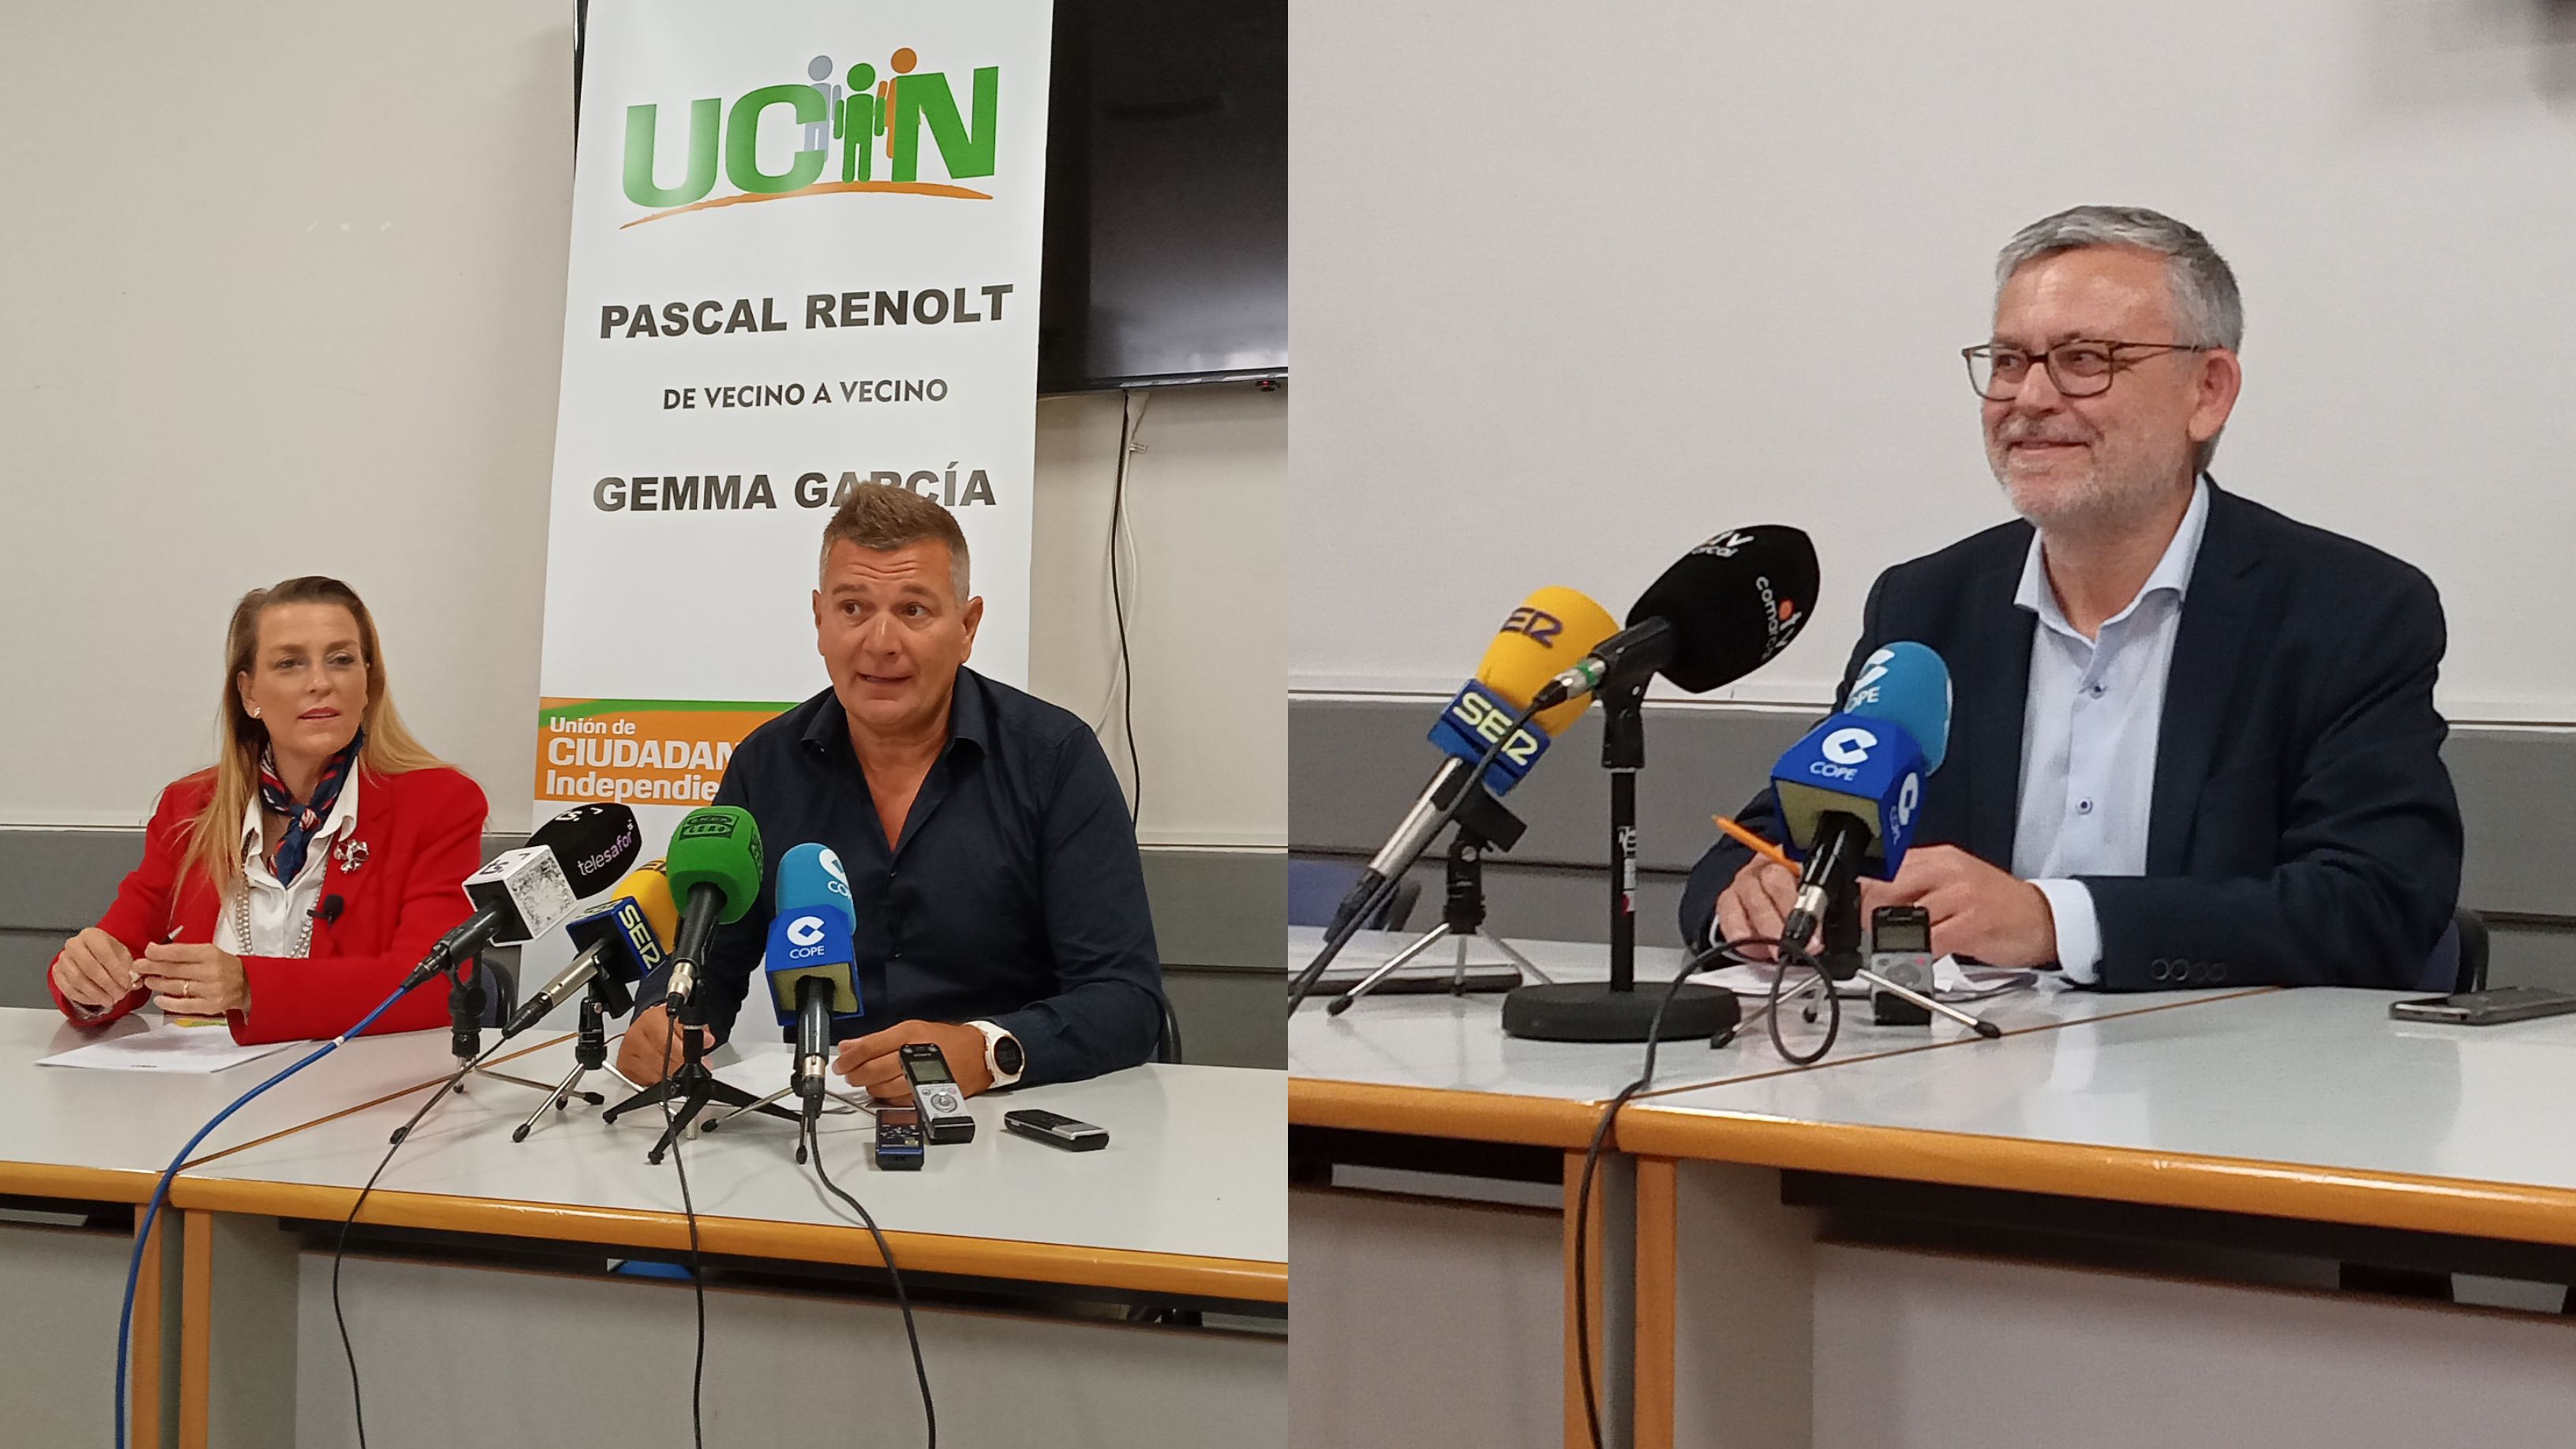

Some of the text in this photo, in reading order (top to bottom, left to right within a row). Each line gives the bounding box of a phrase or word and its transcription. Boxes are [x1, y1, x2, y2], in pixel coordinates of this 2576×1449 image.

[600, 284, 1013, 339] PASCAL RENOLT
[663, 379, 948, 410] DE VECINO A VECINO
[593, 474, 777, 512] GEMMA
[550, 717, 636, 735] Unión de
[546, 769, 720, 803] Independie
[1810, 762, 1859, 781] COPE
[577, 831, 632, 876] telesafor
[789, 945, 826, 960] COPE
